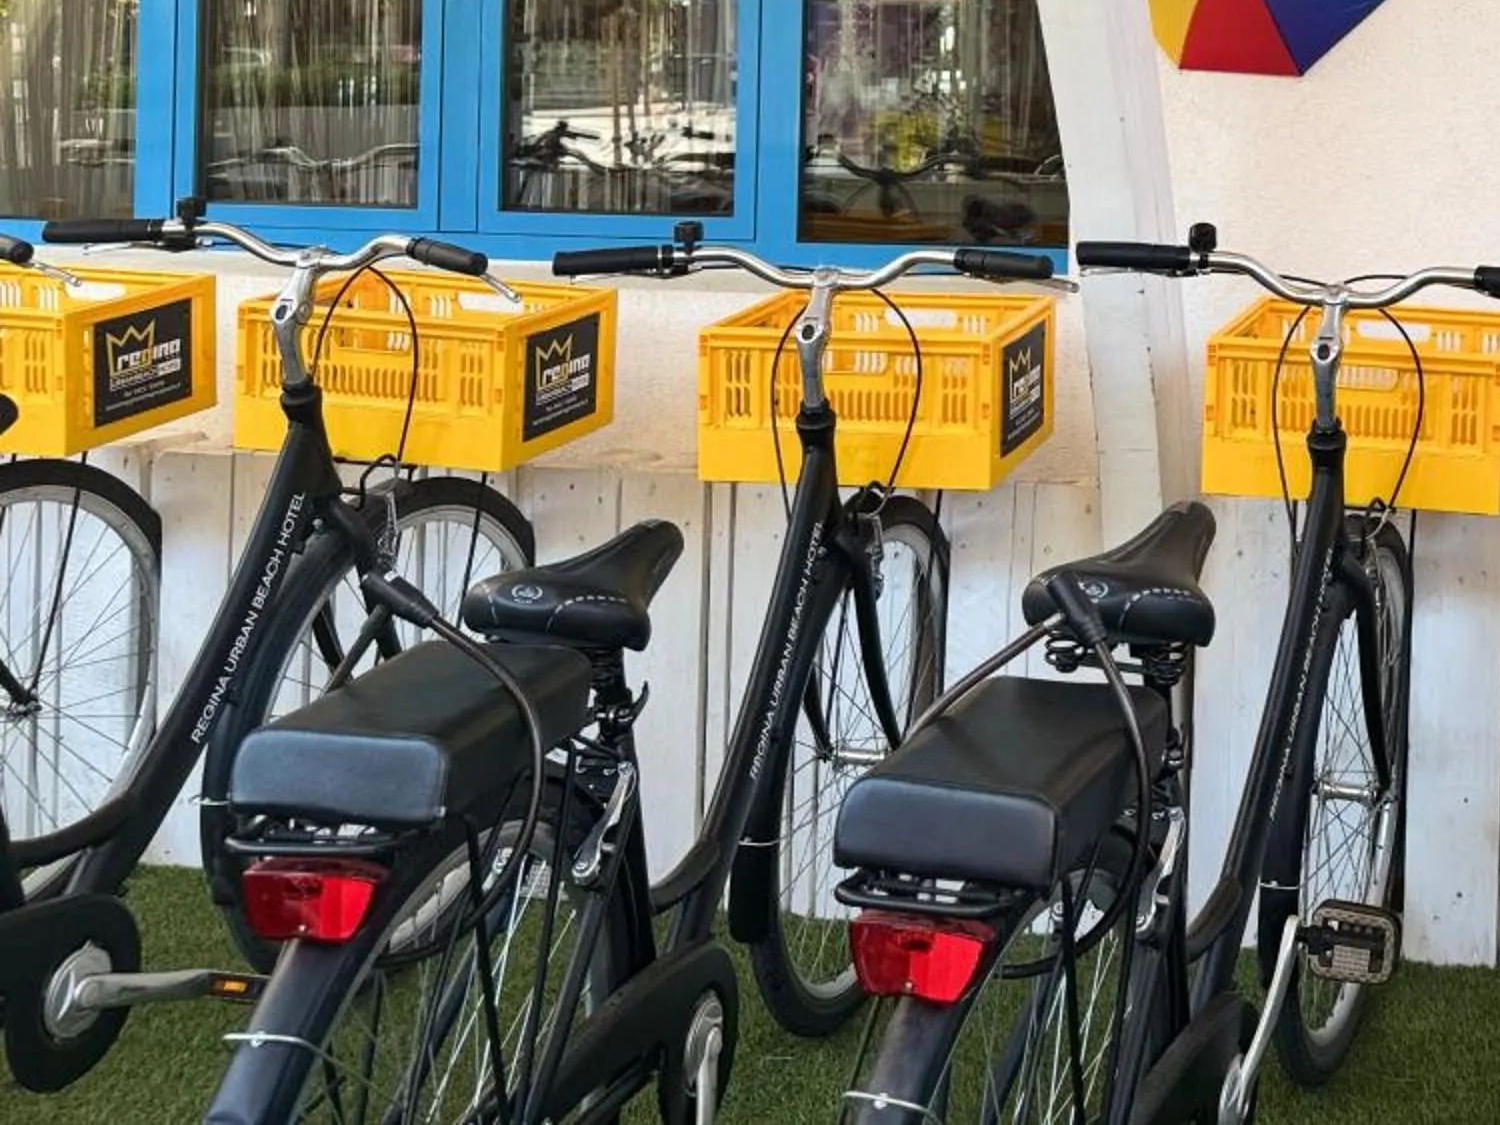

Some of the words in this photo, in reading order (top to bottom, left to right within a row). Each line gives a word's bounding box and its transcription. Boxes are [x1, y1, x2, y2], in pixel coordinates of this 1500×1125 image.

[191, 675, 231, 744] REGINA
[224, 610, 258, 673] URBAN
[252, 549, 284, 610] BEACH
[277, 491, 306, 546] HOTEL
[771, 643, 793, 707] URBAN
[804, 522, 823, 574] HOTEL
